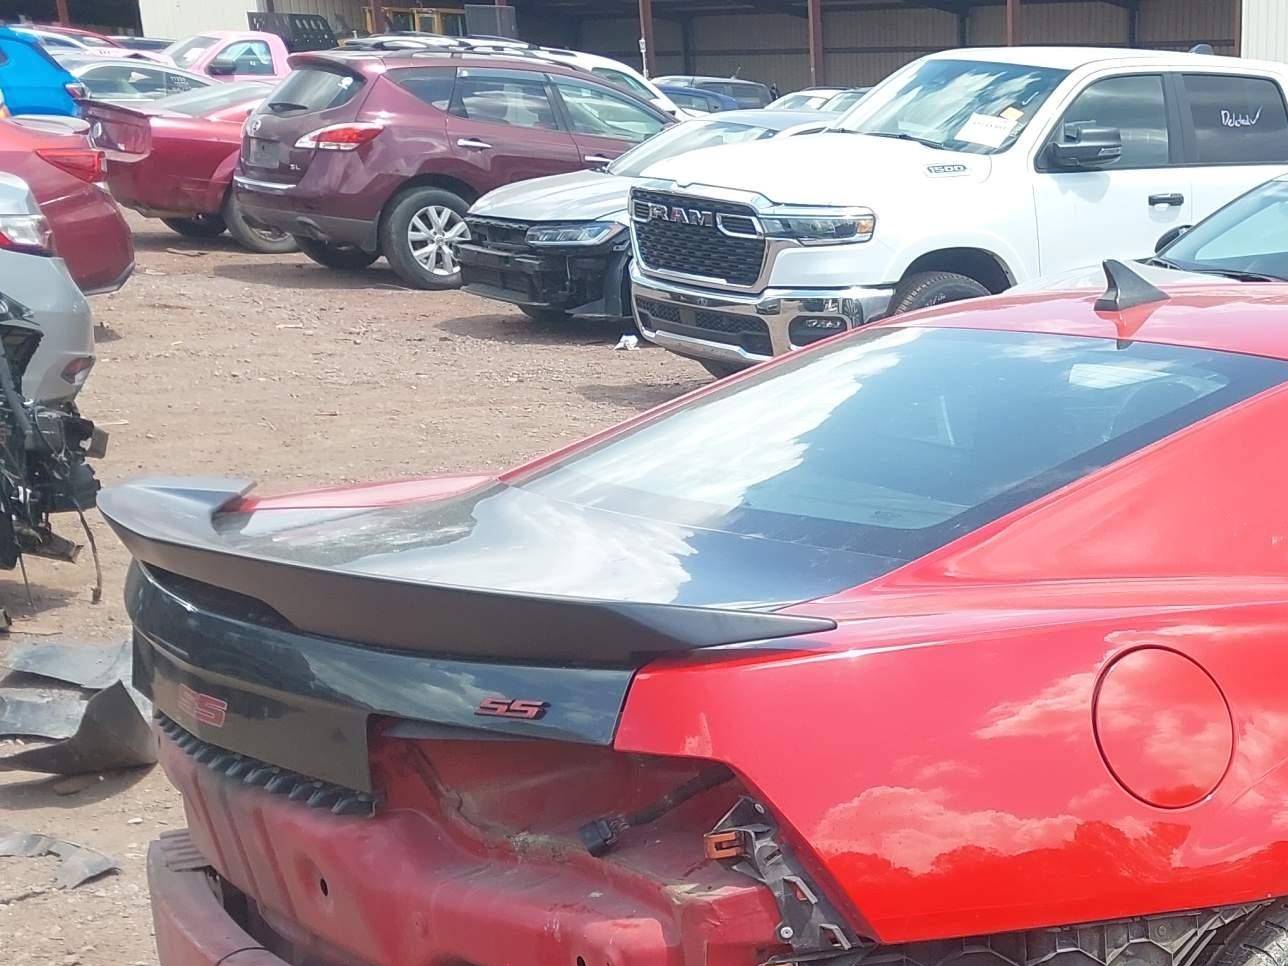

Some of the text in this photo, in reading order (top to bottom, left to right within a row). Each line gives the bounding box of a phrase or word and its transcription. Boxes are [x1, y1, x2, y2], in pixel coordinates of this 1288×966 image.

[927, 164, 967, 174] 1500
[647, 202, 713, 227] RAM
[474, 697, 547, 720] SS
